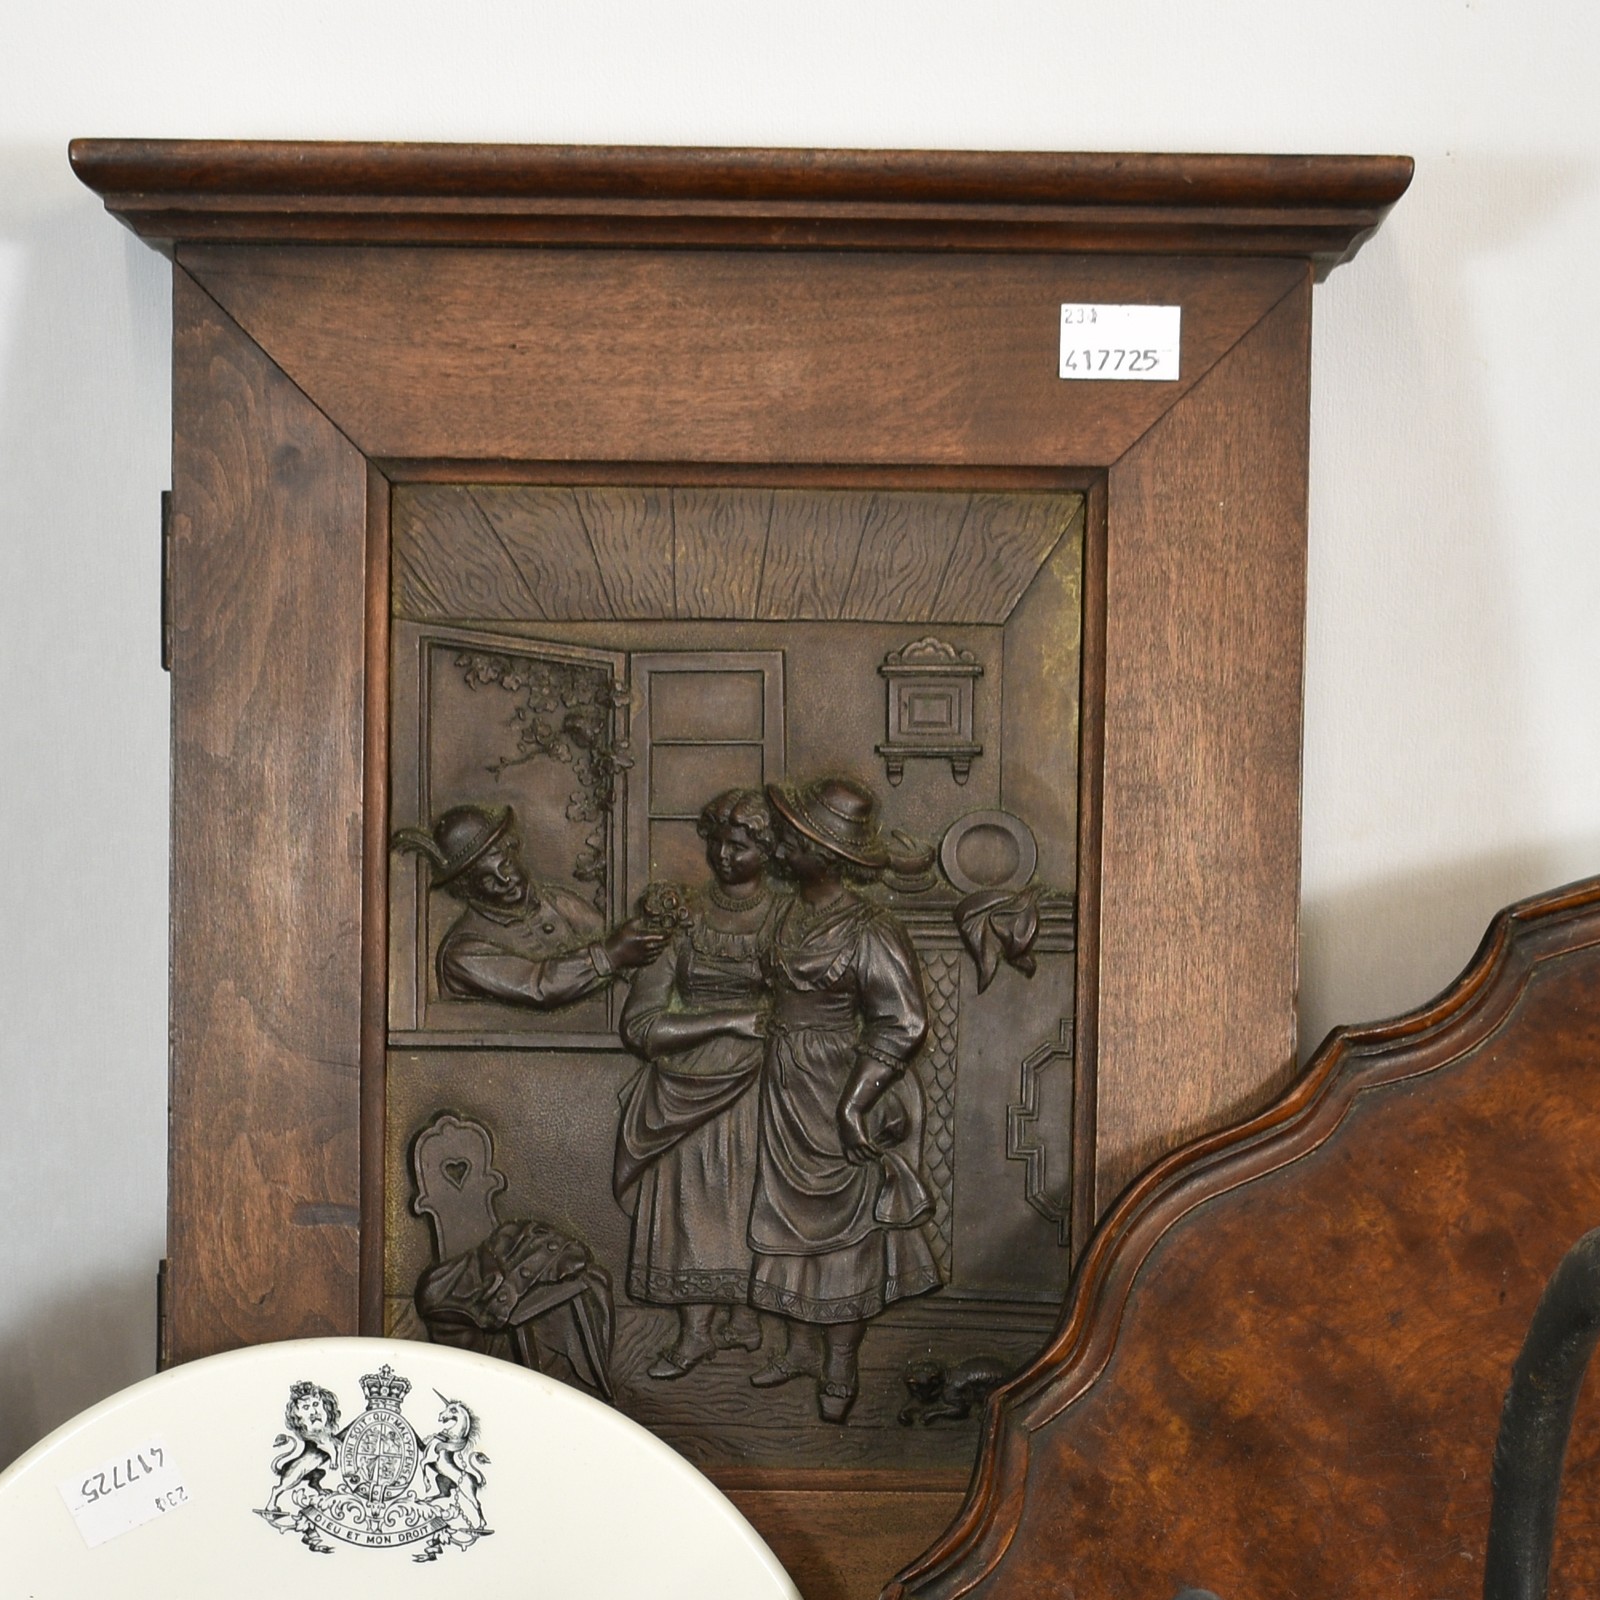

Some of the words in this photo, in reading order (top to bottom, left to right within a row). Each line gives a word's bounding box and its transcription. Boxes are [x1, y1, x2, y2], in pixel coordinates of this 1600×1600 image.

[1064, 349, 1159, 371] 417725
[349, 1417, 369, 1440] SOIT
[373, 1412, 391, 1422] QUI
[393, 1419, 409, 1440] MAL
[81, 1447, 165, 1504] 417725
[314, 1513, 342, 1535] DIEU
[346, 1530, 361, 1541] ET
[366, 1535, 392, 1545] MON
[398, 1525, 430, 1543] DROIT
